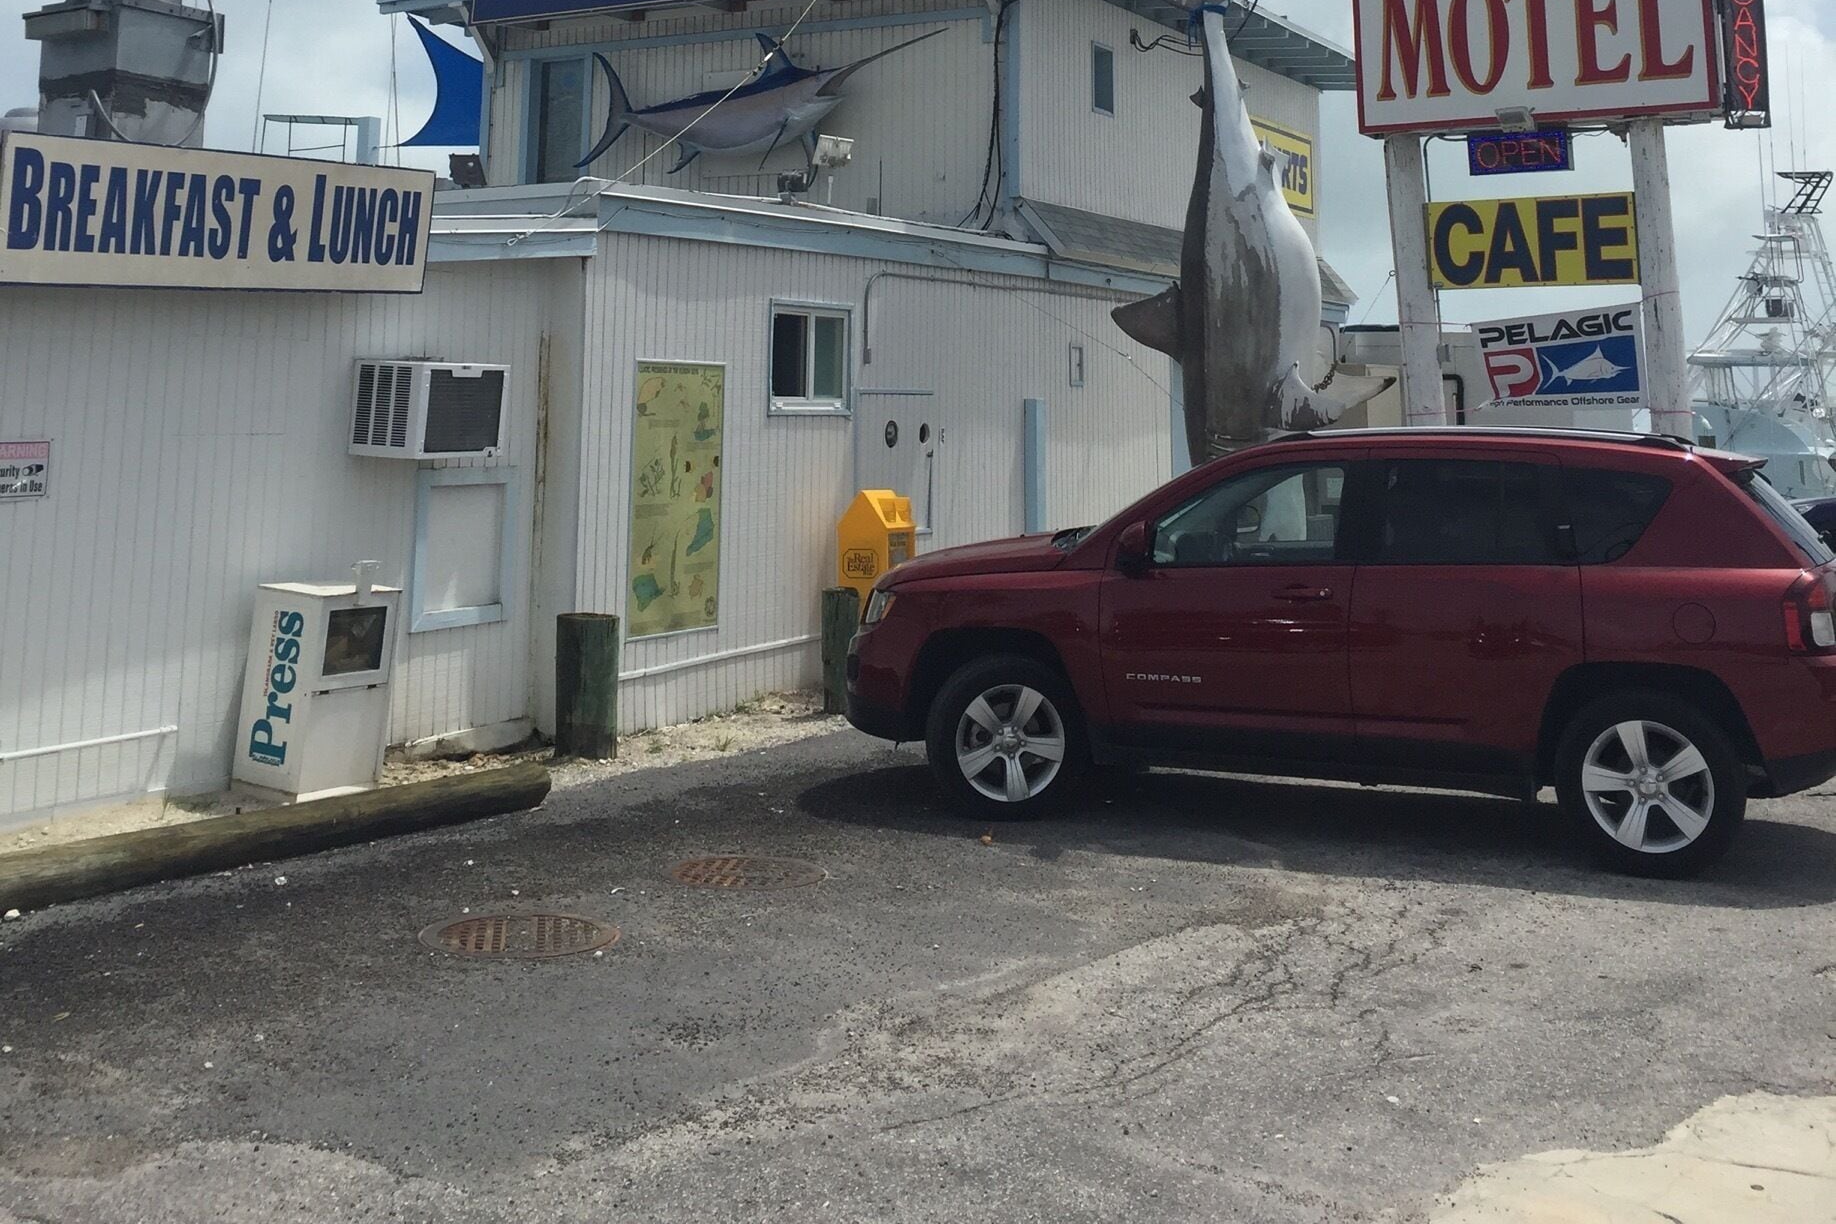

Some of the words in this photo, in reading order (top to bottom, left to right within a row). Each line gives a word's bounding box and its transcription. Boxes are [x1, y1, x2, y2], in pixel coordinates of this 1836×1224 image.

[1476, 138, 1562, 169] OPEN
[7, 147, 261, 260] BREAKFAST
[268, 184, 297, 263] &
[307, 174, 422, 266] LUNCH
[1434, 196, 1634, 286] CAFE
[1479, 310, 1634, 348] PELAGIC
[1571, 396, 1614, 405] Offshore
[1617, 395, 1640, 404] Gear
[30, 480, 42, 493] Use
[249, 610, 304, 765] Press
[1126, 673, 1201, 683] COMPASS
